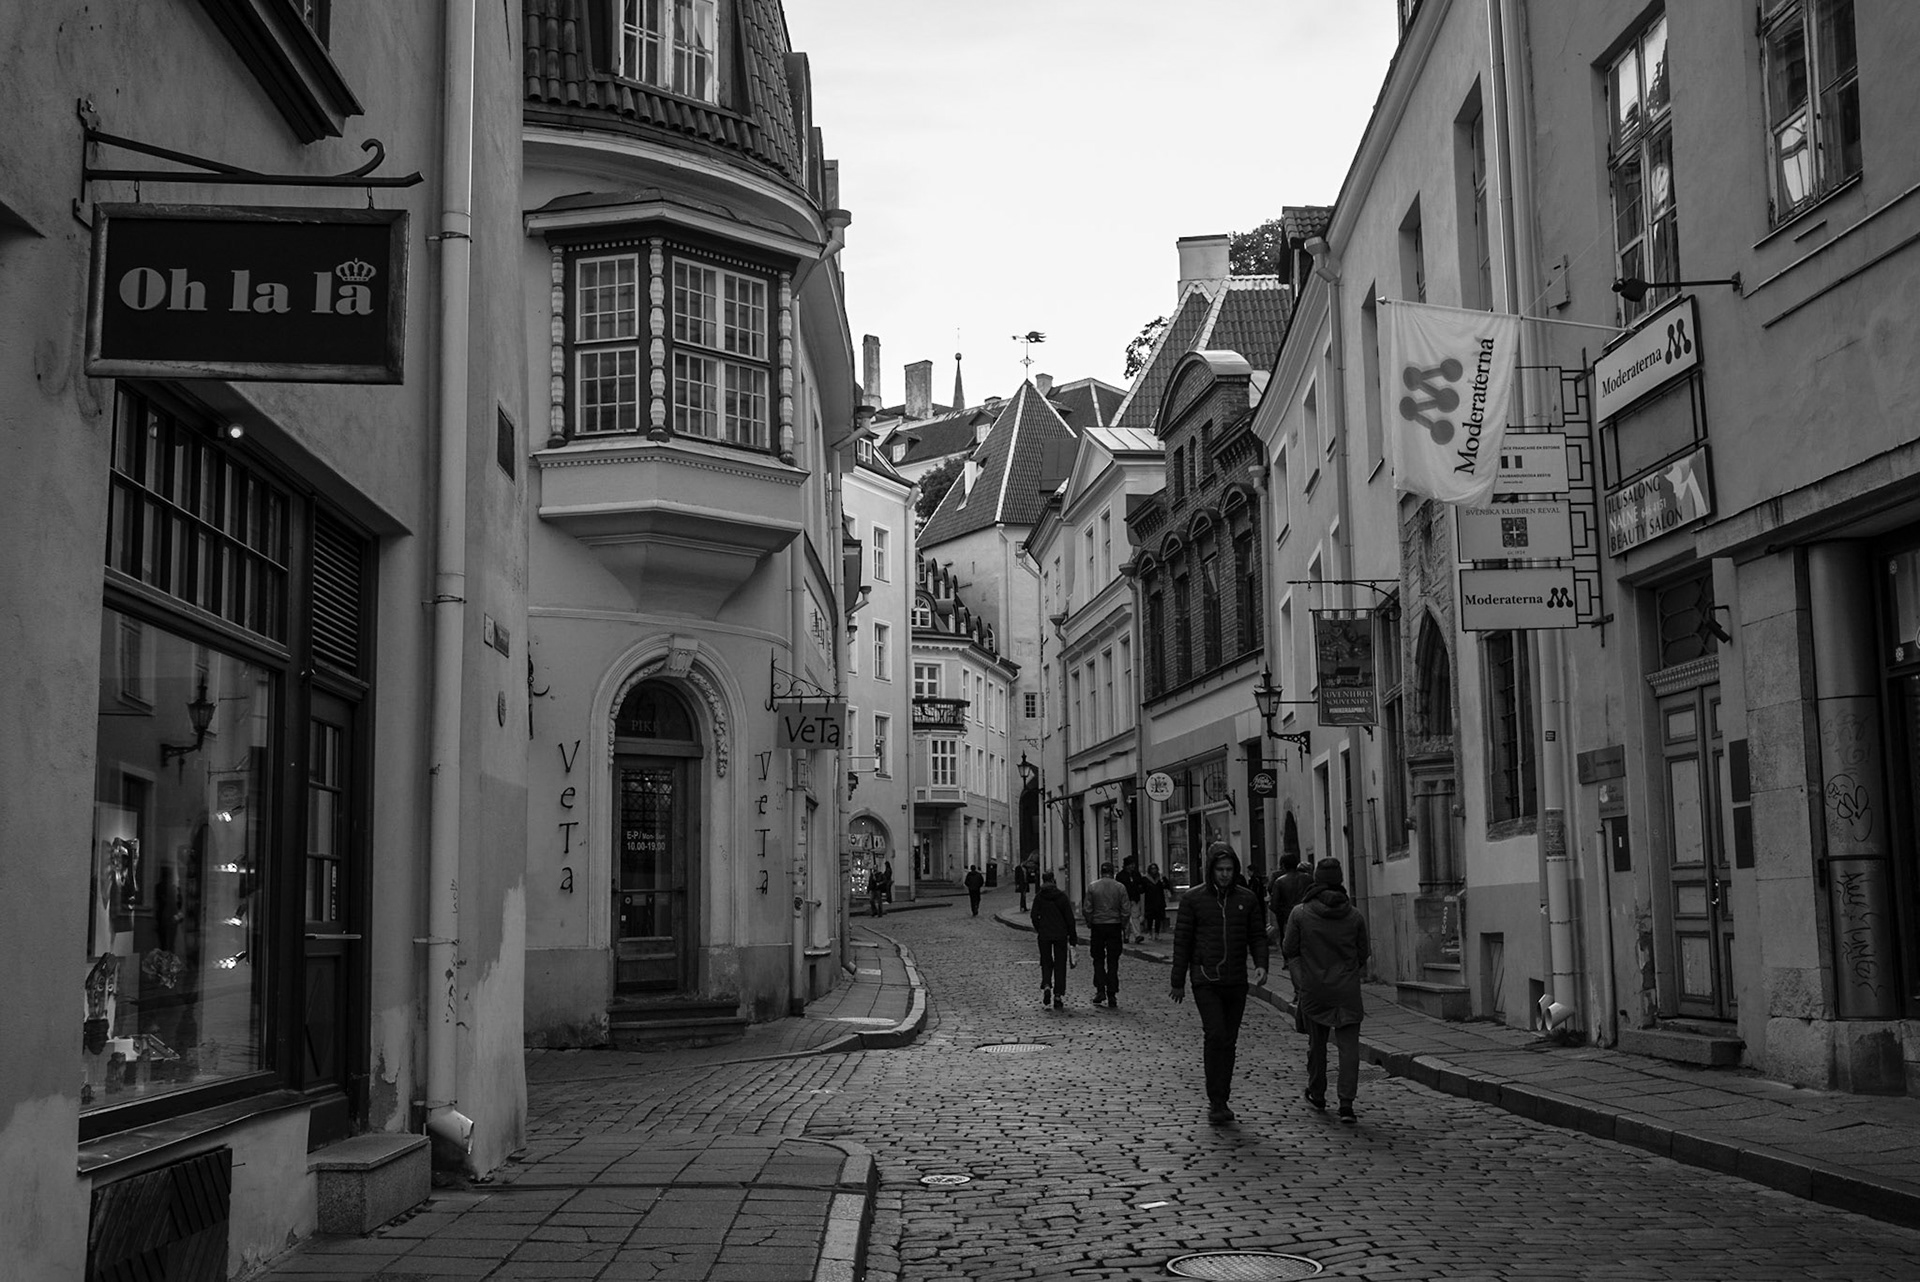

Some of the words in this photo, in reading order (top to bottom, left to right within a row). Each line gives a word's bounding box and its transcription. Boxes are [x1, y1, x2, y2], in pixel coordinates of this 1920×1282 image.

[119, 267, 208, 311] Oh
[228, 270, 291, 313] la
[1601, 346, 1663, 398] Moderaterna
[1453, 337, 1495, 475] Moderaterna
[1465, 508, 1500, 516] SVENSKA
[1608, 475, 1661, 514] ILUSALONG
[1610, 522, 1646, 551] BEAUTY
[1649, 506, 1683, 535] SALON
[1465, 593, 1543, 606] Moderaterna
[785, 715, 841, 747] VeTa
[558, 740, 581, 893] VeTa
[755, 750, 772, 895] VeTa
